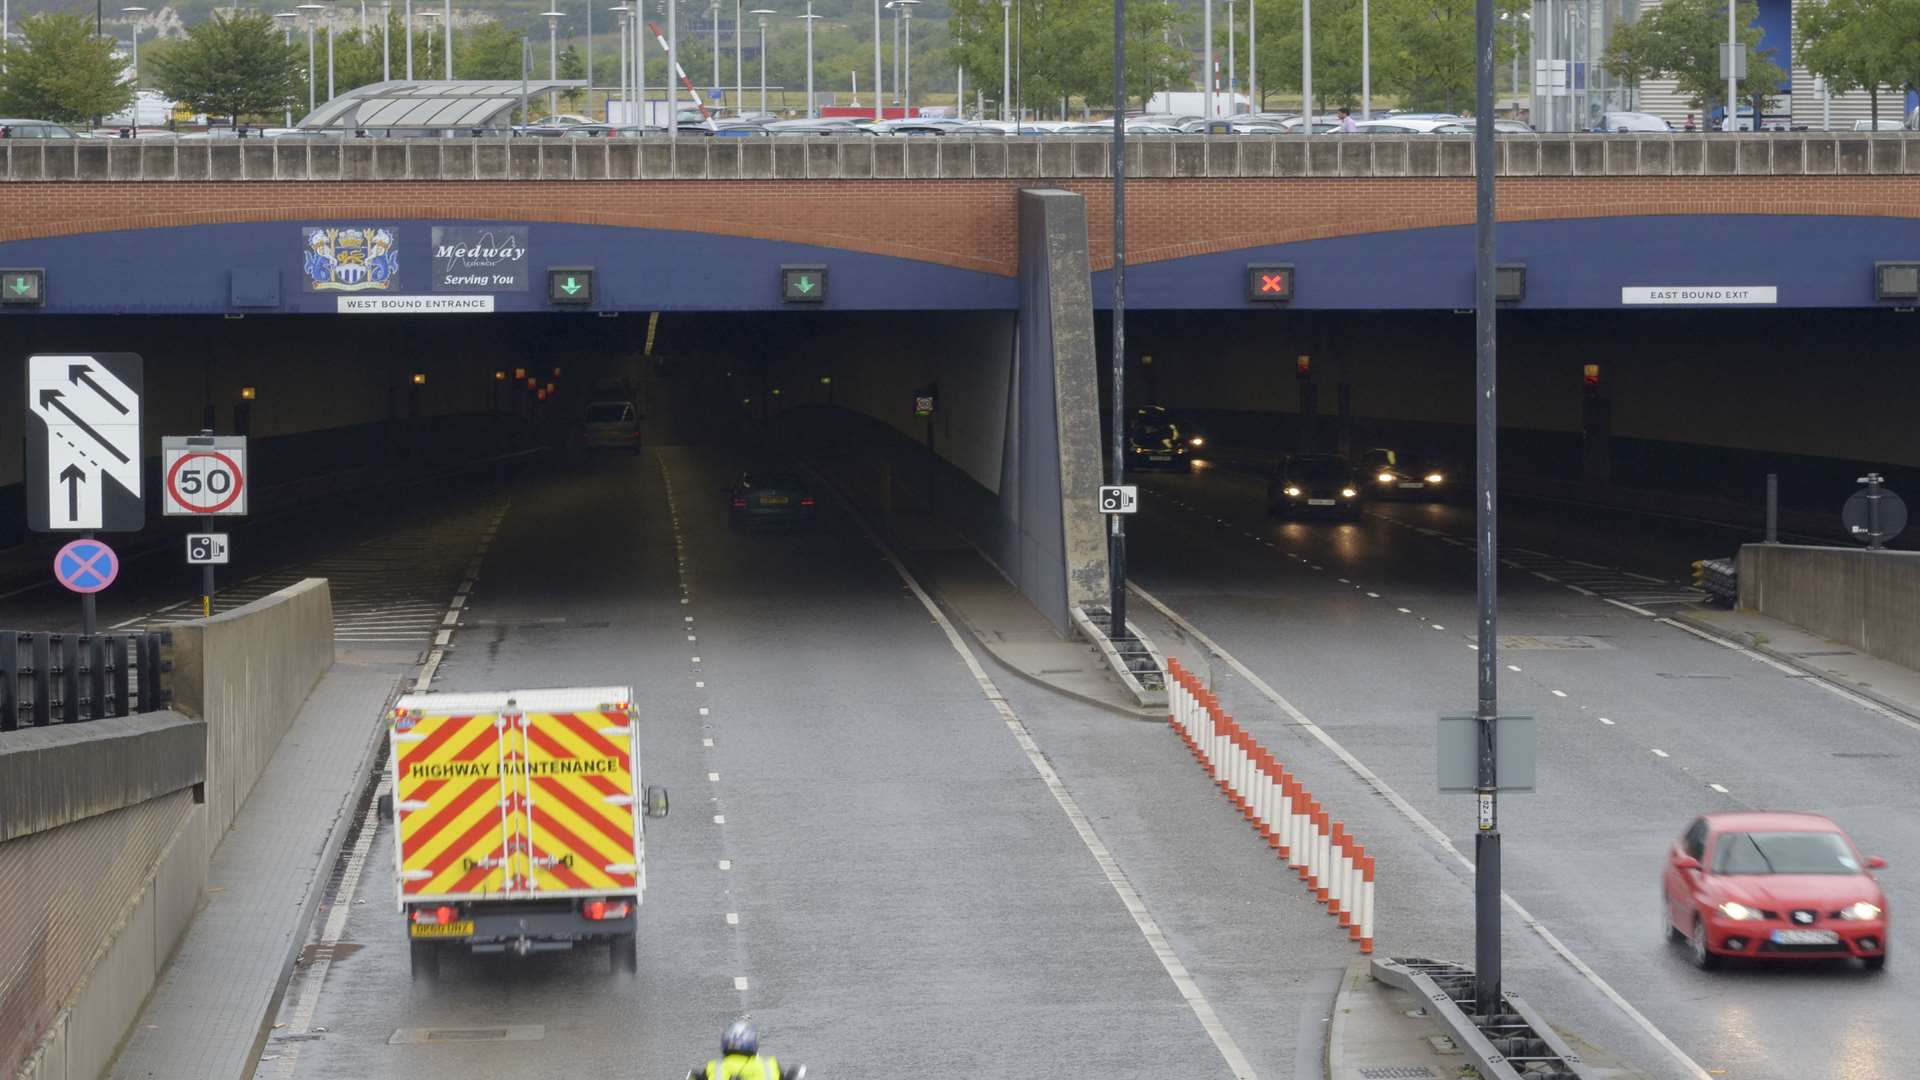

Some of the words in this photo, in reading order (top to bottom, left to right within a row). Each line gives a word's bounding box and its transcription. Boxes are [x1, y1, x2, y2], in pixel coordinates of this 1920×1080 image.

[434, 245, 525, 261] Medway
[444, 274, 488, 286] Serving
[492, 274, 514, 285] You
[1650, 291, 1678, 299] EAST
[1681, 291, 1722, 299] BOUND
[1725, 291, 1749, 299] EXIT
[346, 300, 378, 308] WEST
[381, 300, 422, 308] BOUND
[425, 299, 486, 308] ENTRANCE
[181, 469, 231, 494] 50
[412, 763, 490, 778] HIGHWAY
[496, 758, 617, 776] MAINTENANCE
